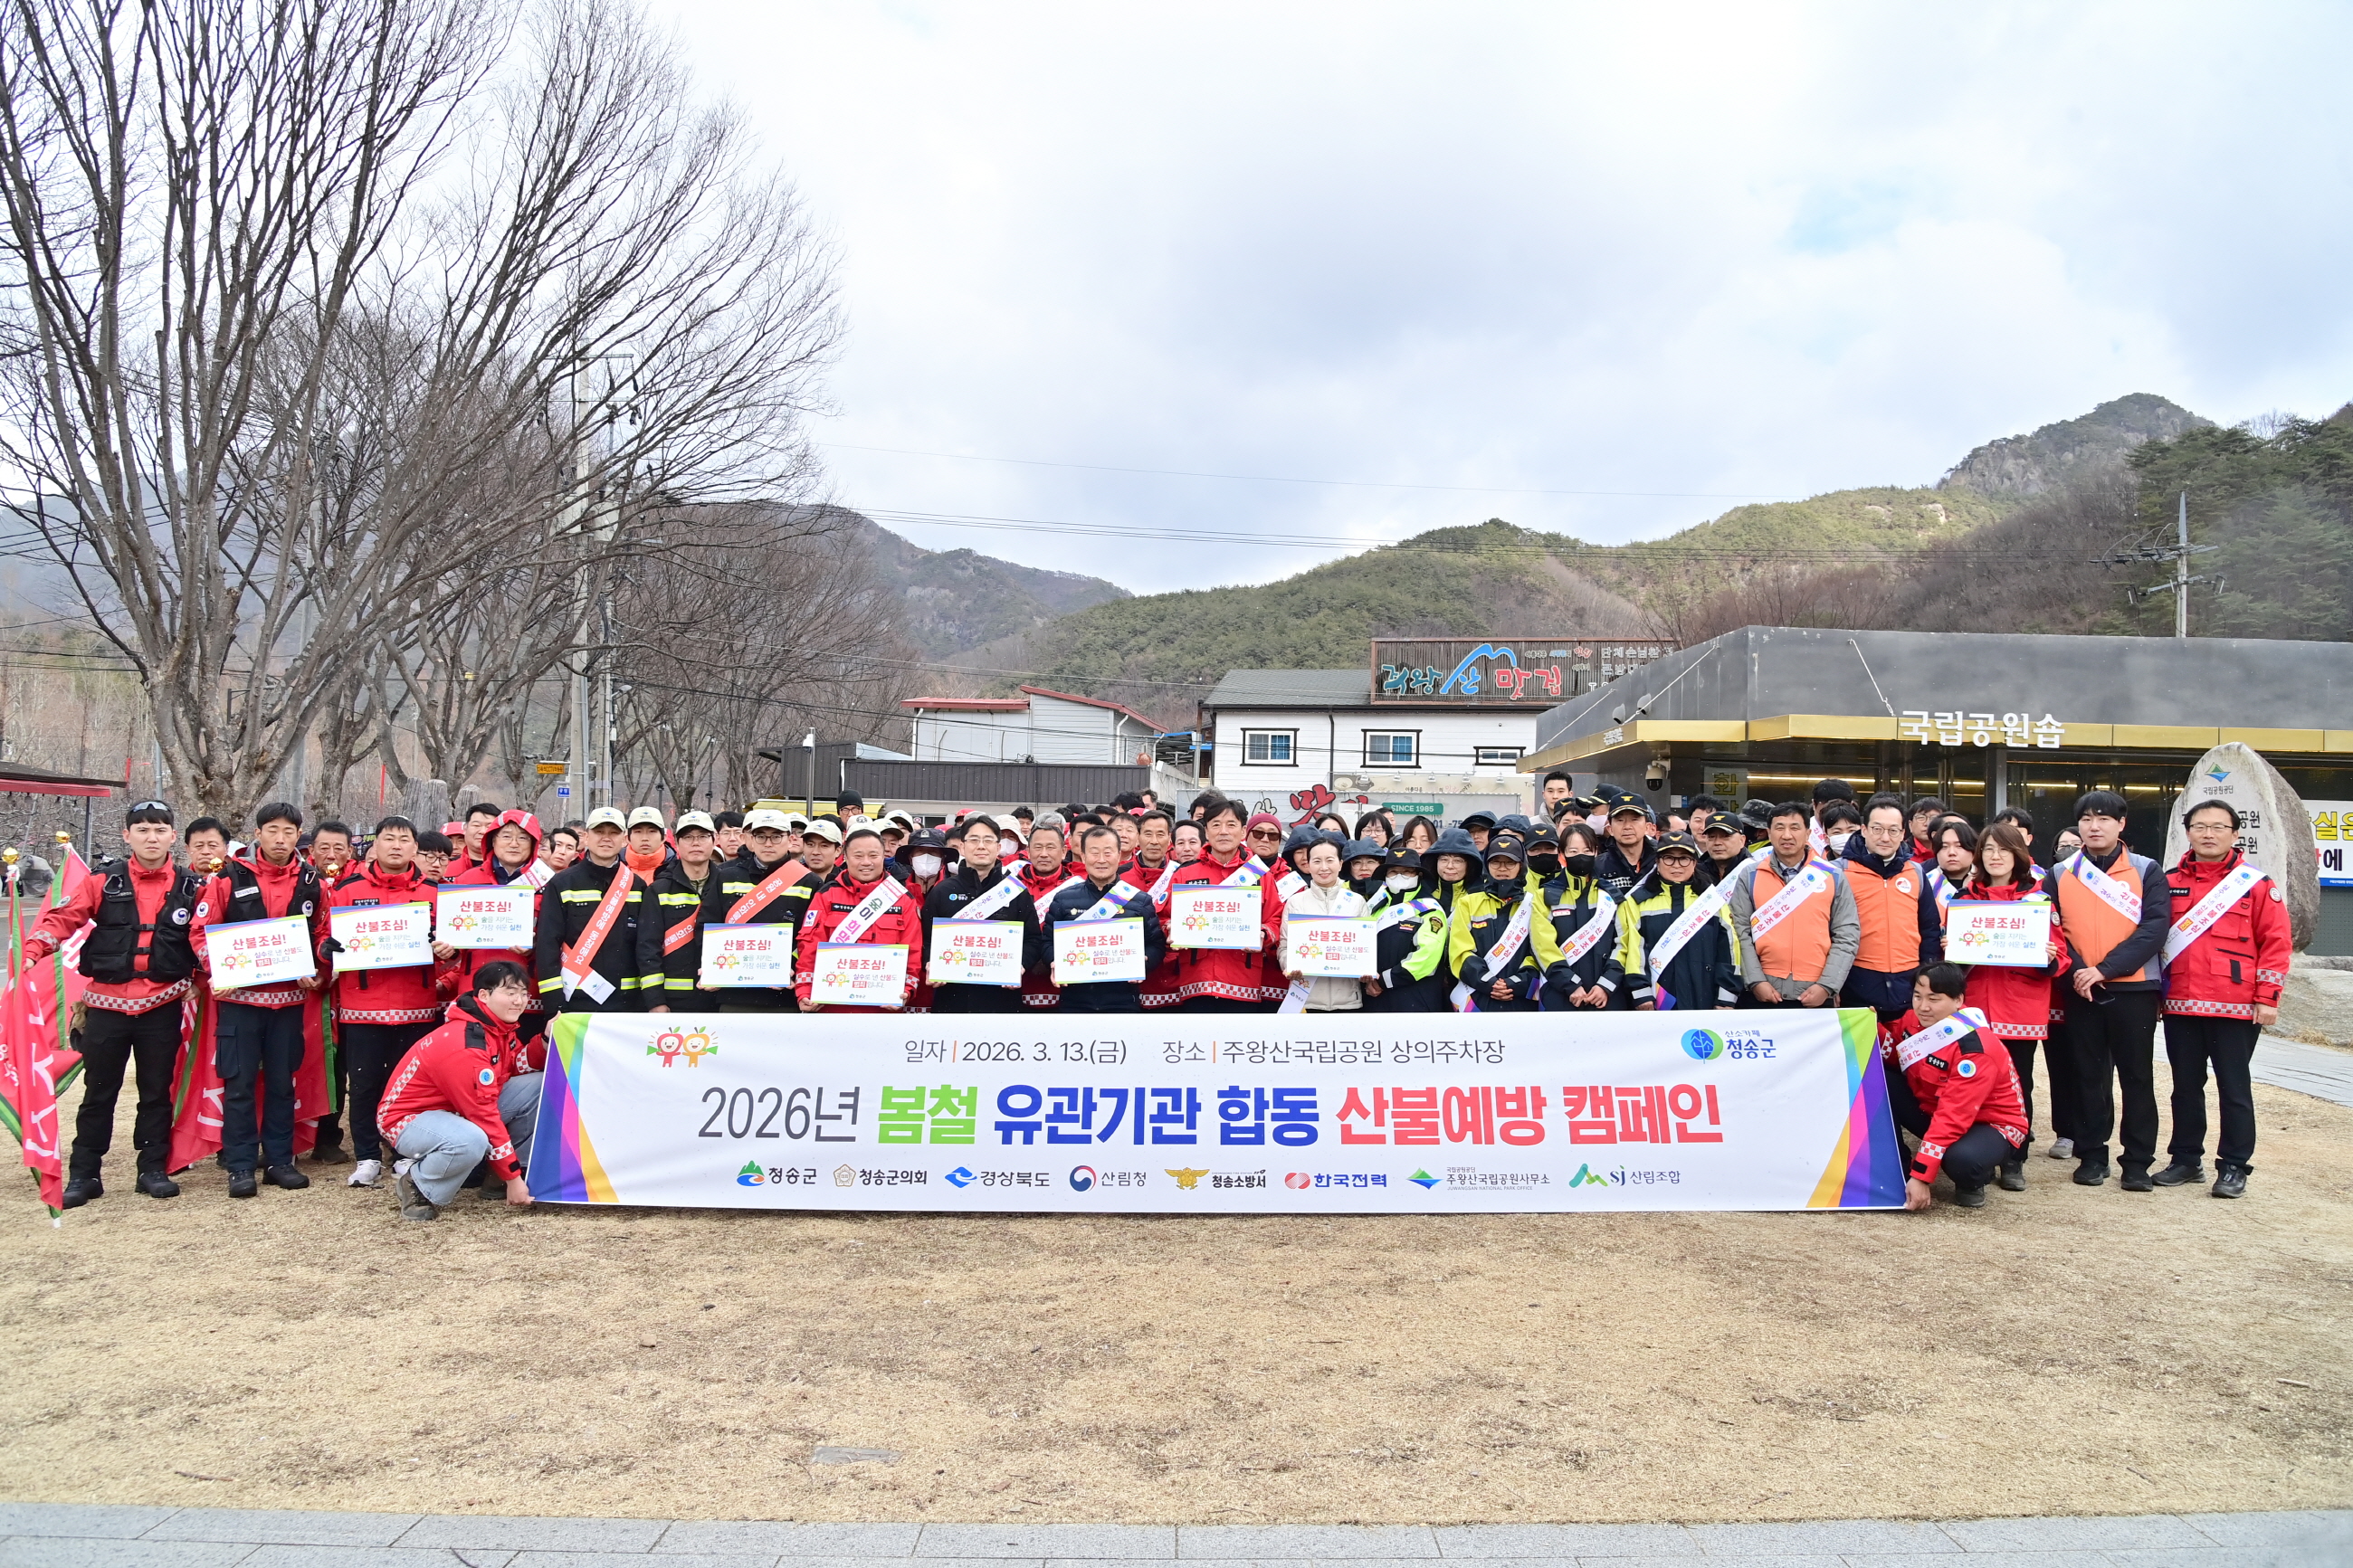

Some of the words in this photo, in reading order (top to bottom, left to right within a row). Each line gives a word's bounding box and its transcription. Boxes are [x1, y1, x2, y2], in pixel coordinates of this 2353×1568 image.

[1495, 665, 1561, 699] 맛집
[1900, 710, 2065, 749] 국립공원숍
[2203, 785, 2234, 795] 국립공원공단
[2308, 811, 2353, 841] 실은
[765, 876, 783, 895] 공원
[755, 890, 766, 901] 내
[461, 901, 511, 912] 산불조심!
[859, 895, 884, 921] 숲이
[1193, 901, 1240, 912] 산불조심!
[356, 919, 408, 933] 산불조심!
[1676, 907, 1710, 944] 산불조심!
[1752, 900, 1790, 938] 산불조심!
[1971, 917, 2024, 929] 산불조심!
[2184, 899, 2224, 941] 산불조심!
[834, 918, 861, 946] 희망
[1309, 930, 1356, 943] 산불조심!
[233, 935, 286, 950] 산불조심!
[724, 940, 771, 950] 산불조심!
[953, 936, 1001, 948] 산불조심!
[1075, 935, 1122, 947] 산불조심!
[1500, 926, 1527, 965] 산불조심!
[1567, 923, 1602, 964] 산불조심!
[254, 950, 273, 958] 실수로
[284, 946, 303, 955] 산불도
[837, 958, 885, 970] 산불조심!
[905, 1040, 947, 1063] 일자
[962, 1042, 1024, 1061] 2026.
[1033, 1042, 1051, 1061] 3.
[1060, 1040, 1126, 1065] 13.(금)
[1163, 1041, 1205, 1063] 장소
[1223, 1041, 1382, 1063] 주왕산국립공원
[1390, 1040, 1505, 1063] 상의주차장
[1726, 1039, 1777, 1060] 청송군
[699, 1087, 860, 1142] 2026년
[878, 1085, 977, 1145] 봄철
[995, 1085, 1201, 1145] 유관기관
[1217, 1086, 1319, 1146] 합동
[1336, 1086, 1547, 1145] 산불예방
[1563, 1084, 1723, 1145] 캠페인
[769, 1167, 816, 1184] 청송군
[860, 1168, 928, 1185] 청송군의회
[980, 1171, 1050, 1187] 경상북도
[1101, 1172, 1147, 1187] 산림청
[1212, 1175, 1266, 1188] 청송소방서
[1314, 1174, 1387, 1188] 한국전력
[1446, 1174, 1550, 1185] 주왕산국립공원사무소
[1630, 1170, 1681, 1184] 산림조합
